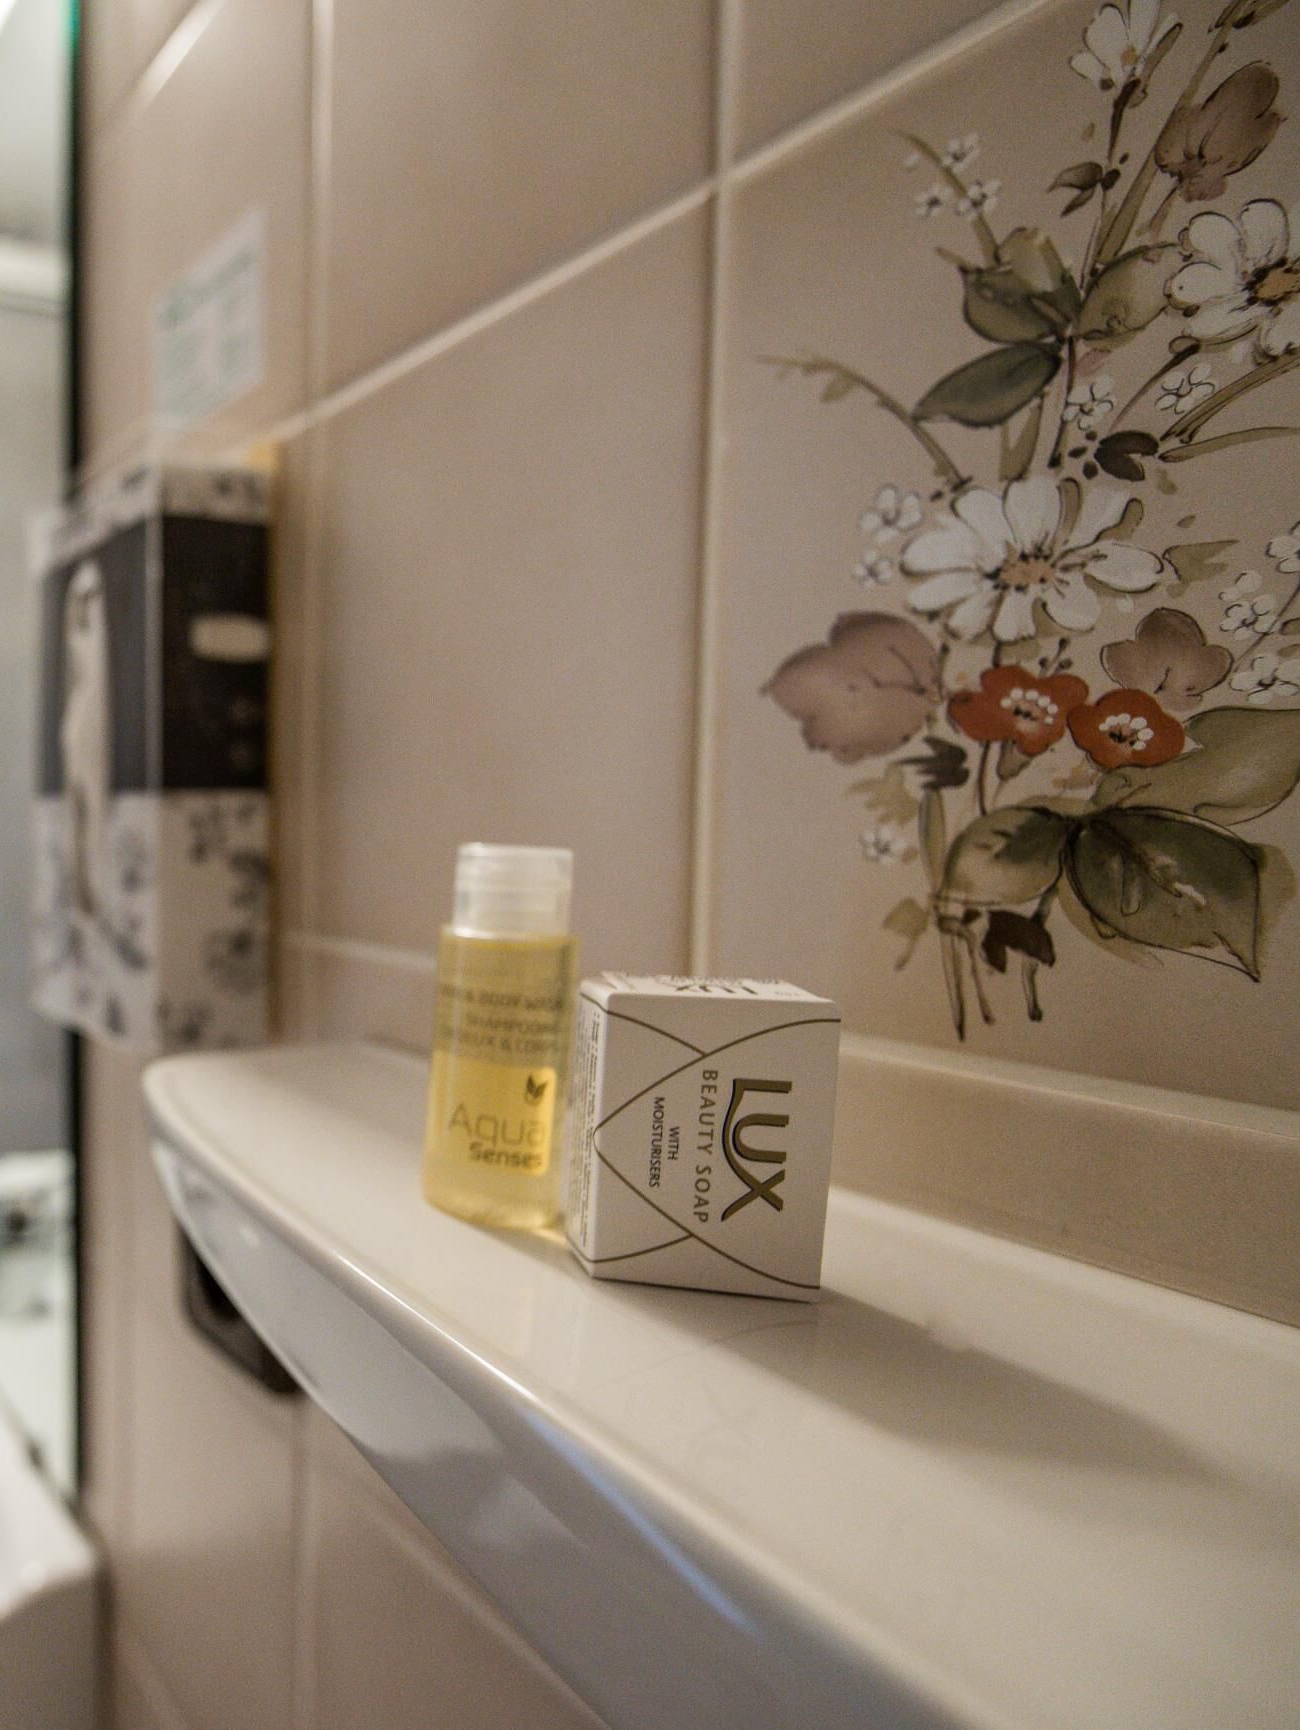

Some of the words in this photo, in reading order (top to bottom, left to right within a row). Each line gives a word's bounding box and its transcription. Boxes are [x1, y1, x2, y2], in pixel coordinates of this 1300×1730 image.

[448, 1102, 546, 1148] Aqua
[696, 1069, 718, 1156] BEAUTY
[468, 1141, 543, 1169] Senses
[648, 1097, 666, 1189] MOISTURISERS
[667, 1126, 680, 1161] WITH
[720, 1078, 792, 1222] LUX
[693, 1165, 712, 1223] SOAP
